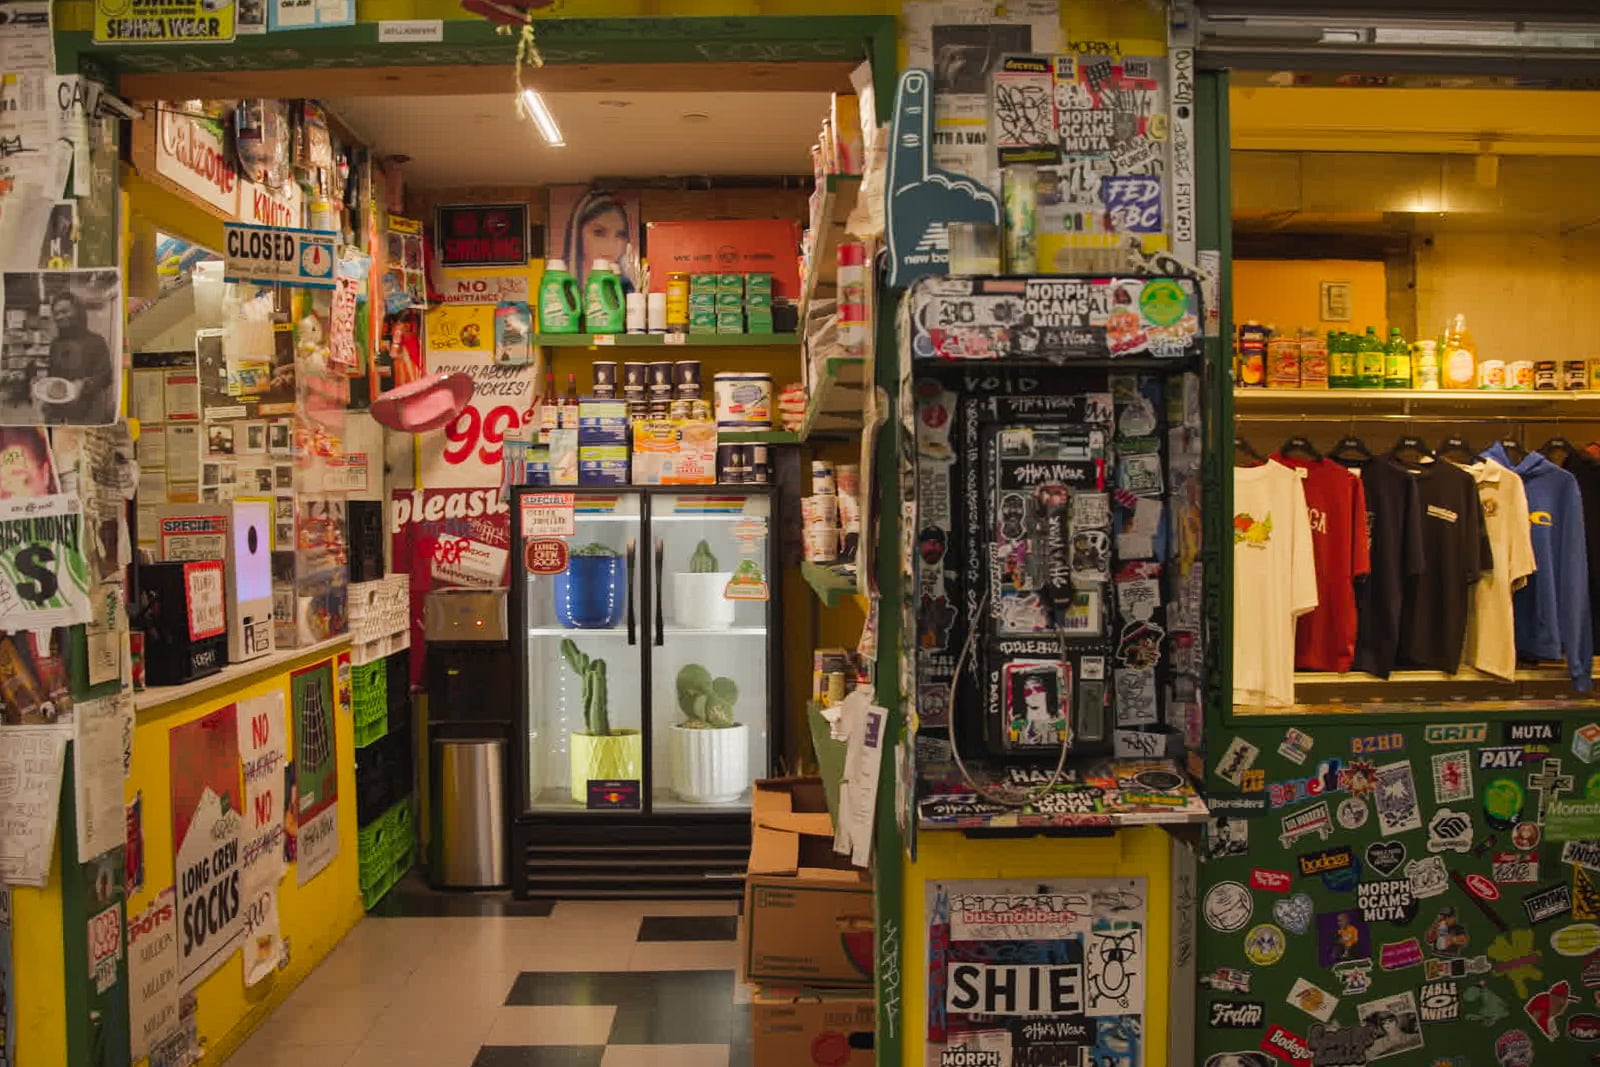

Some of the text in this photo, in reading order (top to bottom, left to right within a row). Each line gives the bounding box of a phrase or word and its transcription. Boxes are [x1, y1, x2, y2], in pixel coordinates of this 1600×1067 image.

[1058, 111, 1113, 124] MORPH
[1059, 124, 1114, 137] OCAMS
[1065, 137, 1109, 150] MUTA
[1108, 180, 1160, 202] FED
[228, 230, 295, 262] CLOSED
[904, 253, 929, 265] new
[457, 281, 488, 293] NO
[1026, 284, 1089, 300] MORPH
[1026, 300, 1090, 315] OCAMS
[1033, 314, 1082, 327] MUTA
[35, 513, 80, 553] MONEY
[252, 713, 269, 750] NO
[1511, 726, 1552, 742] MUTA
[255, 790, 272, 829] NO
[182, 857, 211, 899] LONG
[212, 838, 239, 883] CREW
[1358, 880, 1411, 896] MORPH
[1358, 893, 1411, 909] OCAMS
[183, 869, 241, 958] SOCKS
[1364, 906, 1406, 922] MUTA
[951, 965, 1080, 1012] SHIE
[942, 1052, 997, 1066] MORPH
